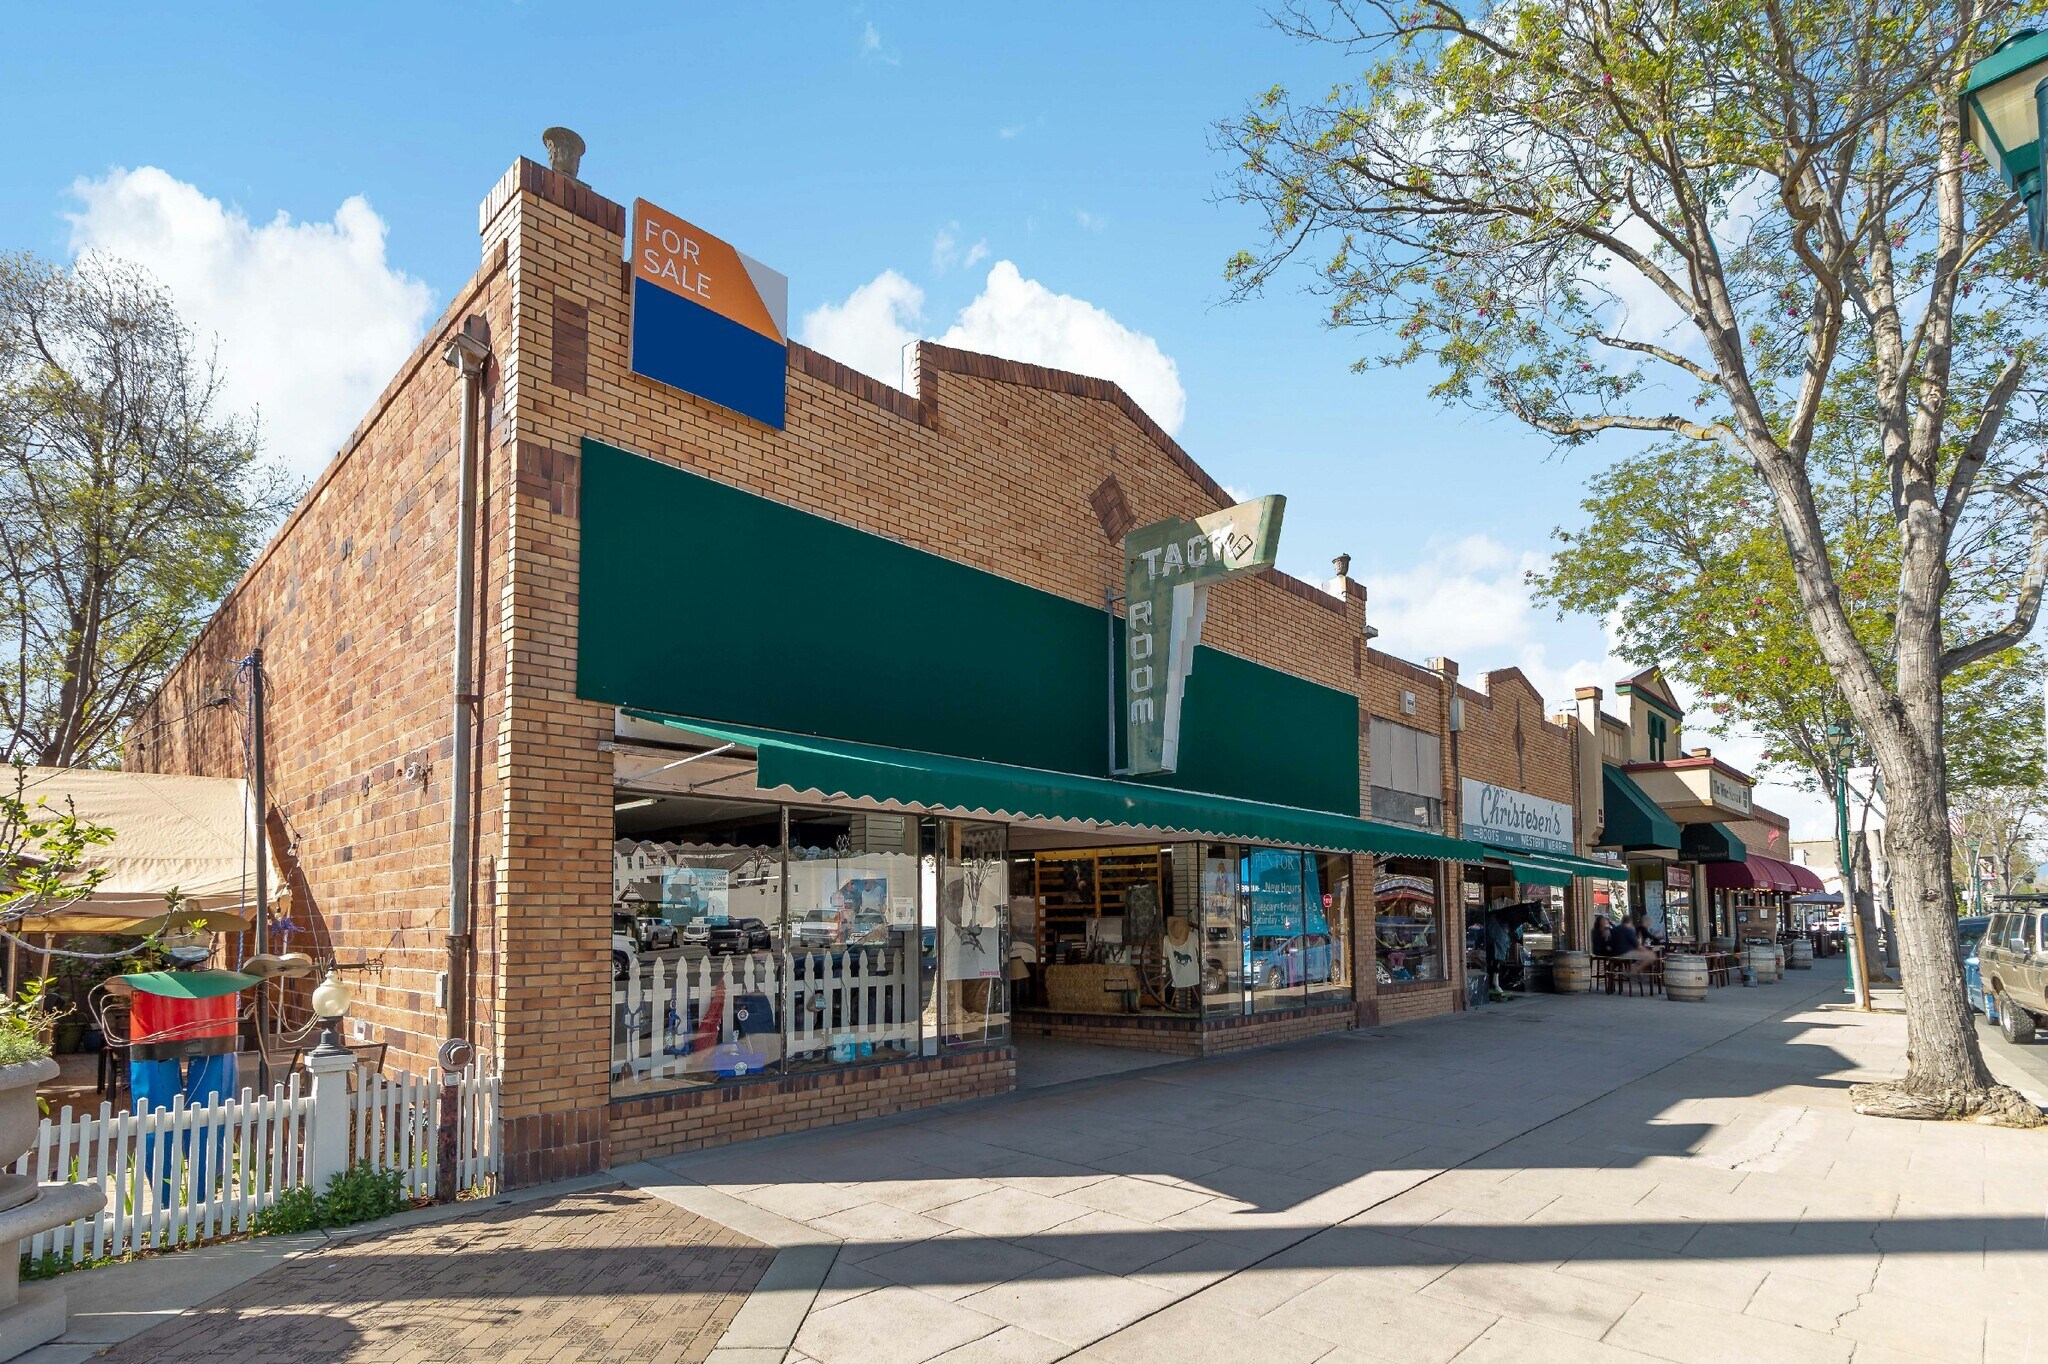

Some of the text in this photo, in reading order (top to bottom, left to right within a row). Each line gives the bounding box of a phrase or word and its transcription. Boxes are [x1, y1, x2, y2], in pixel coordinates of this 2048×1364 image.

[645, 219, 700, 265] FOR
[644, 248, 712, 299] SALE
[1138, 523, 1237, 581] TACK
[1129, 600, 1154, 726] ROOM
[1481, 784, 1562, 835] Christesen's
[1275, 855, 1295, 870] FOR
[1479, 829, 1563, 852] BOOTS WESTERN WEAR
[1280, 882, 1301, 893] Hours
